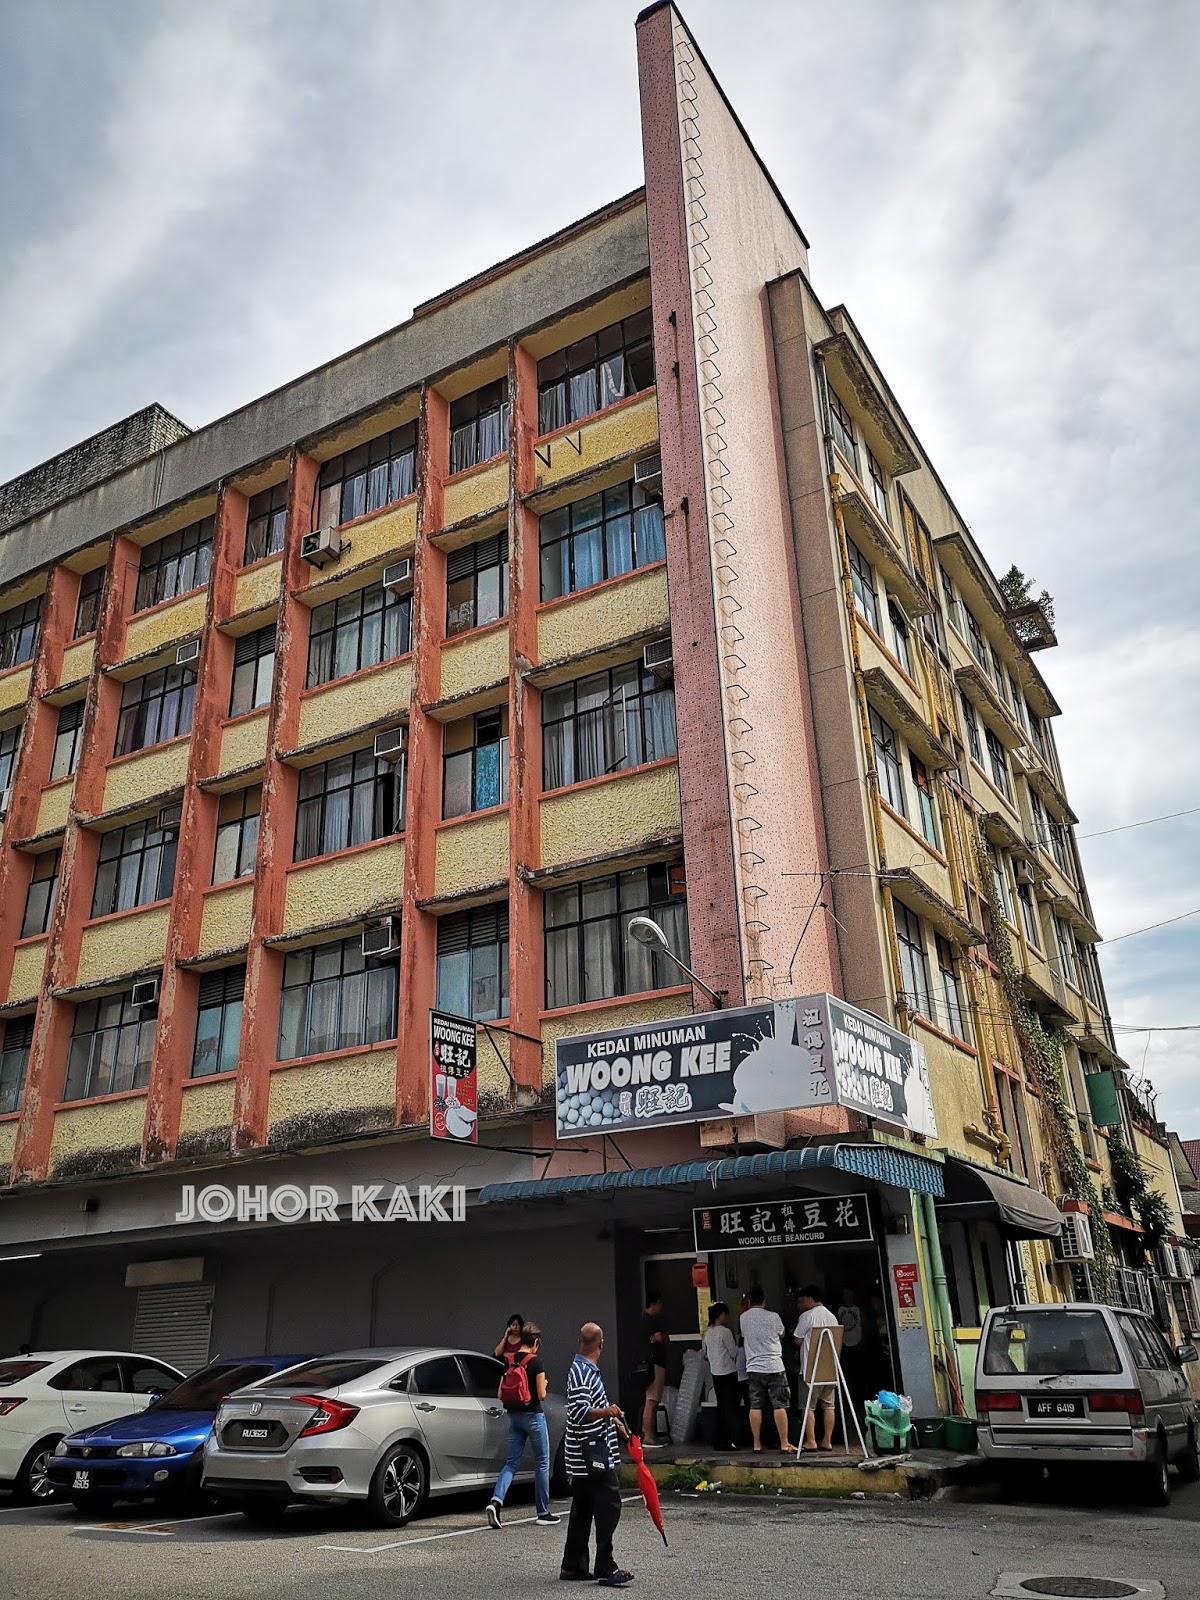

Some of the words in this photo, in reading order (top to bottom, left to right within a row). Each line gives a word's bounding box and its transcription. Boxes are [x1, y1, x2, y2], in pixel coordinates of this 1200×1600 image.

[433, 1017, 449, 1028] KEDAI
[449, 1022, 475, 1034] MINUMAN
[433, 1025, 461, 1044] WOONG
[461, 1032, 475, 1047] KEE
[843, 1013, 863, 1036] KEDAI
[863, 1022, 892, 1050] MINUMAN
[587, 1040, 630, 1058] KEDAI
[634, 1025, 706, 1050] MINUMAN
[565, 1050, 673, 1094] WOONG
[679, 1040, 732, 1078] KEE
[835, 1027, 884, 1077] WOONG
[883, 1050, 903, 1086] KEE
[738, 1235, 765, 1246] WOONG
[767, 1234, 782, 1243] KEE
[785, 1232, 825, 1242] BEANCURD
[1037, 1403, 1052, 1413] AFF
[1056, 1403, 1075, 1413] 6419
